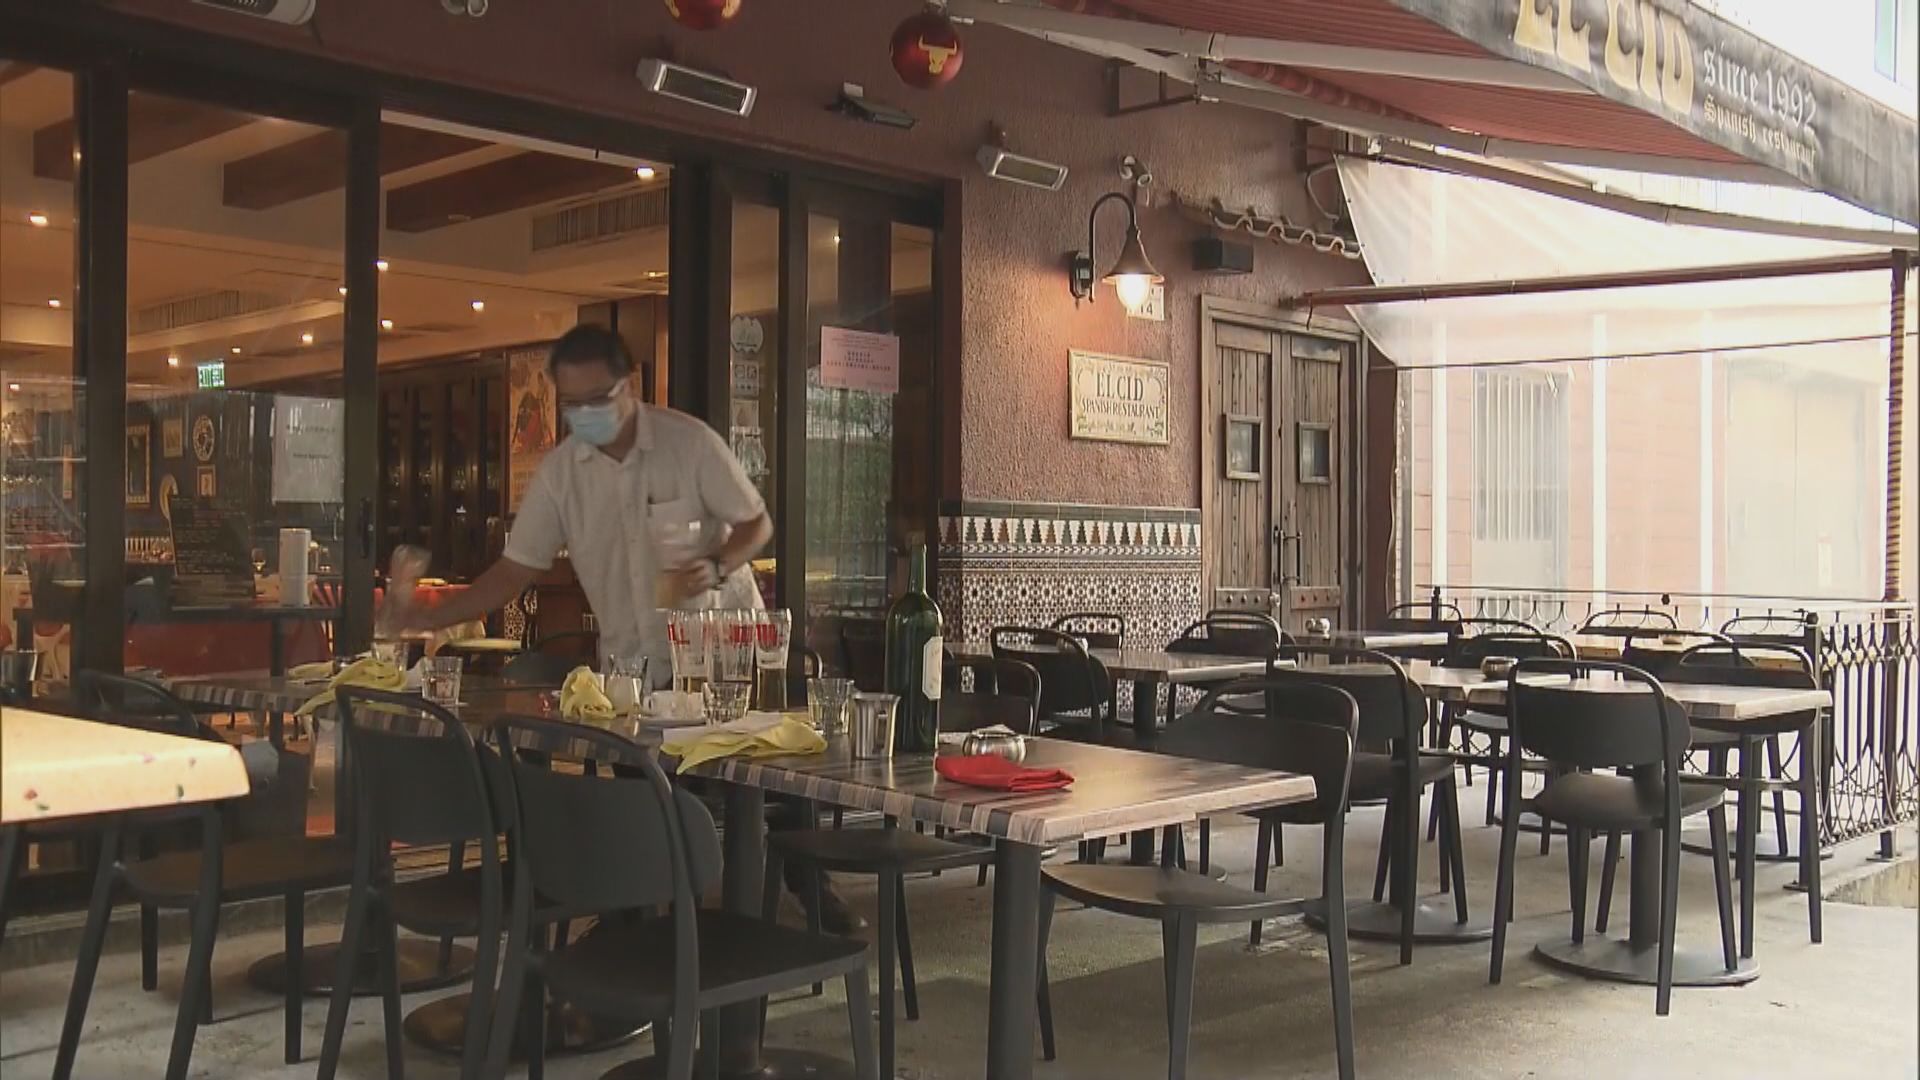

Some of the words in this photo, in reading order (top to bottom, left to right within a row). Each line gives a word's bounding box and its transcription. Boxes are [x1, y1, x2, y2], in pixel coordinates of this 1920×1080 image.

[1605, 0, 1694, 115] CID
[1703, 93, 1756, 143] Spanish
[1766, 68, 1818, 136] 1992
[1096, 372, 1115, 399] EL
[1116, 376, 1144, 401] CID
